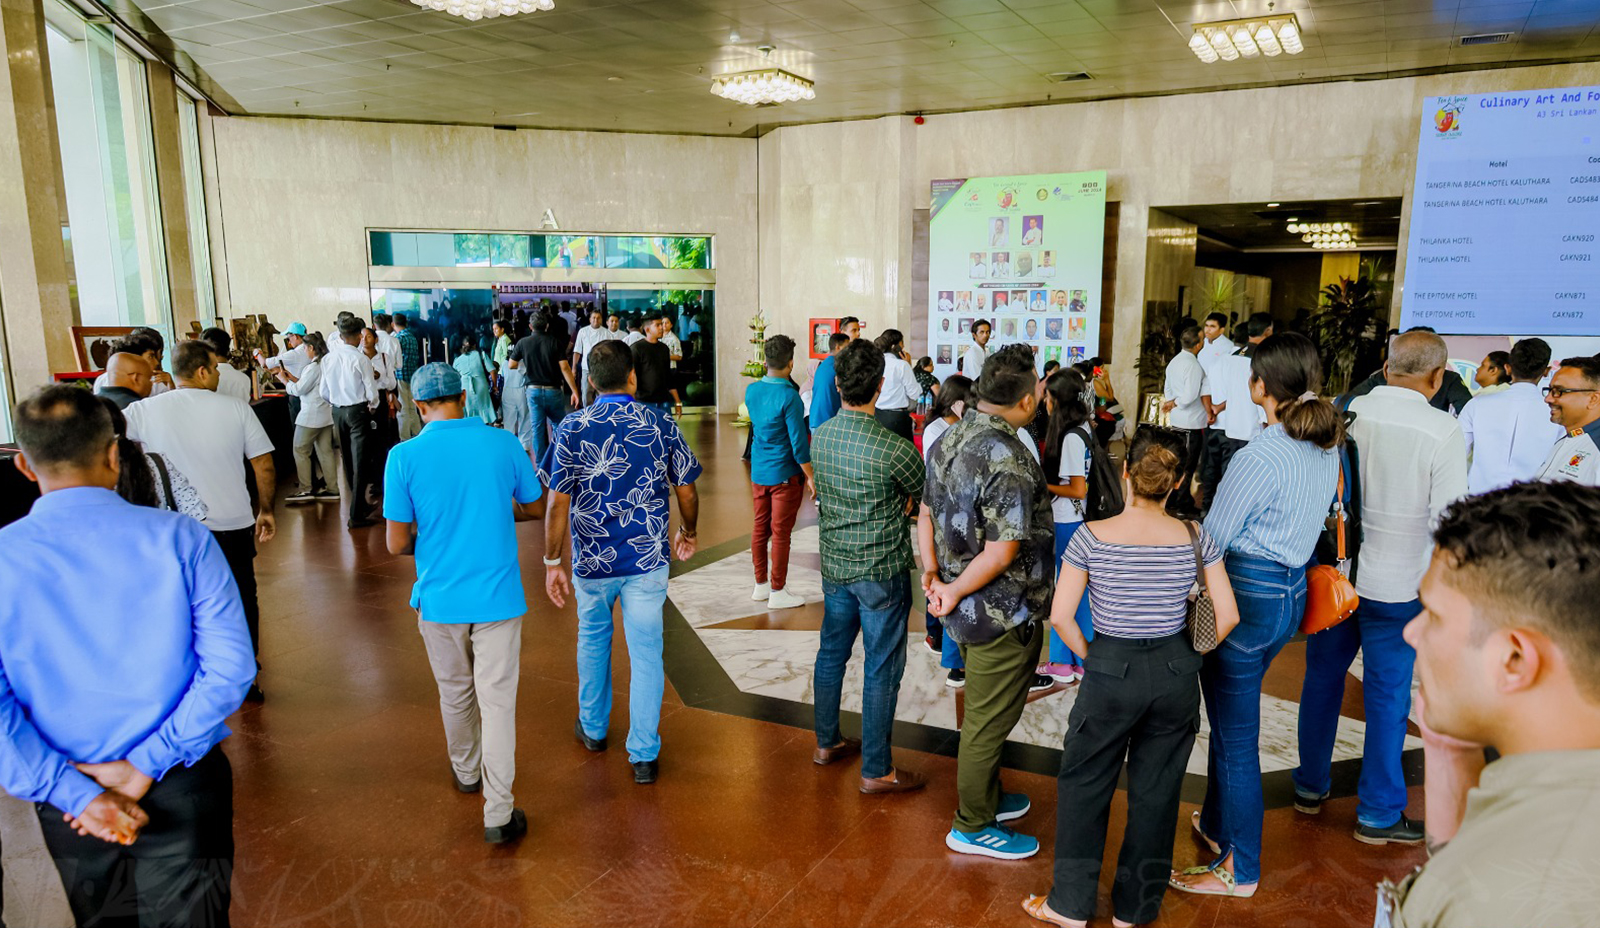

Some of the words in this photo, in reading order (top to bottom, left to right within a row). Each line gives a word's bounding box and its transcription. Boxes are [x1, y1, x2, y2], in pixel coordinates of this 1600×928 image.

[1480, 97, 1530, 108] Culinary
[1536, 94, 1555, 104] Art
[1561, 92, 1581, 103] And
[1550, 109, 1564, 117] Sri
[1569, 108, 1597, 116] Lankan
[1489, 159, 1508, 168] Hotel
[1464, 180, 1486, 188] BEACH
[1487, 179, 1508, 187] HOTEL
[1510, 178, 1550, 186] KALUTHARA
[1462, 199, 1483, 207] BEACH
[1485, 198, 1506, 206] HOTEL
[1508, 197, 1548, 205] KALUTHARA
[539, 208, 559, 230] A
[1420, 237, 1451, 245] THILANKA
[1562, 234, 1595, 242] CAKN920
[1450, 255, 1471, 263] HOTEL
[1414, 292, 1426, 300] THE
[1427, 292, 1456, 300] EPITOME
[1457, 292, 1478, 300] HOTEL
[1412, 310, 1424, 318] THE
[1425, 310, 1454, 318] EPITOME
[1455, 310, 1476, 318] HOTEL
